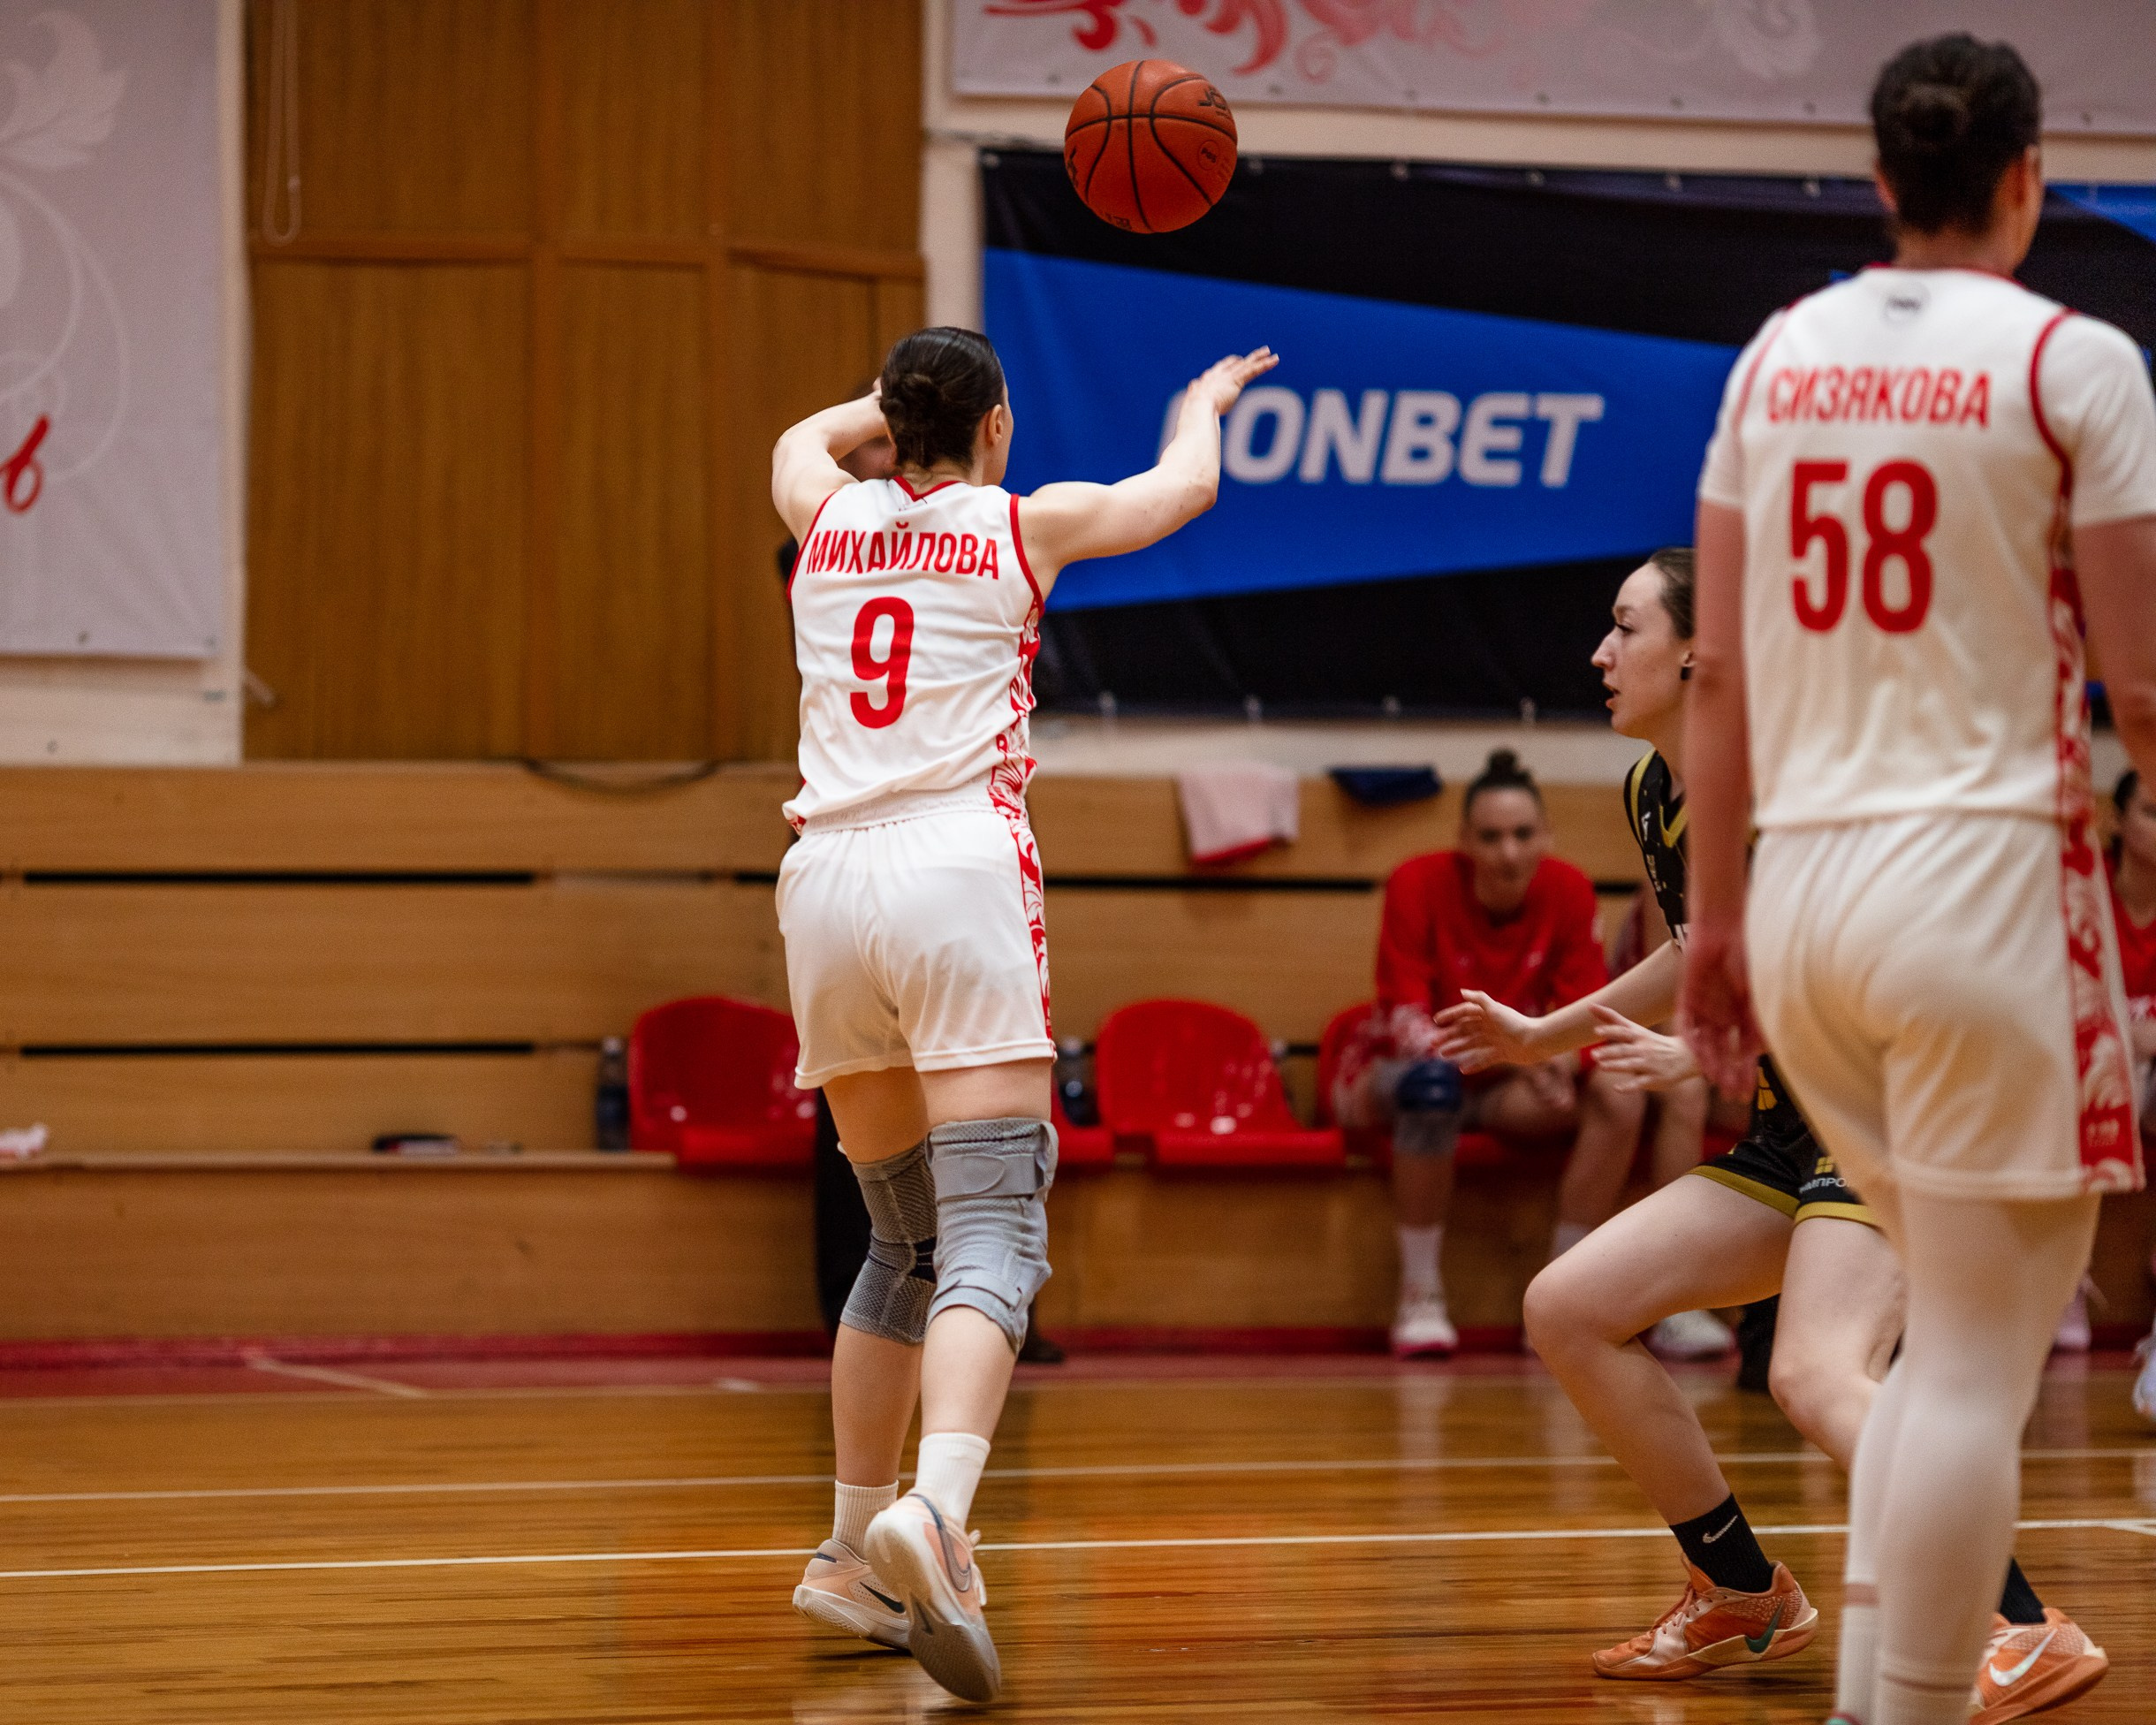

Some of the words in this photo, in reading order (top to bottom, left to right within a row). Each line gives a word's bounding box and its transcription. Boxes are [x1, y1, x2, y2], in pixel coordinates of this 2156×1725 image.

[1768, 366, 1992, 429] СИЗЯКОВА
[806, 521, 999, 580] МИХАЙЛОВА
[1790, 459, 1937, 635] 58
[850, 596, 915, 729] 9
